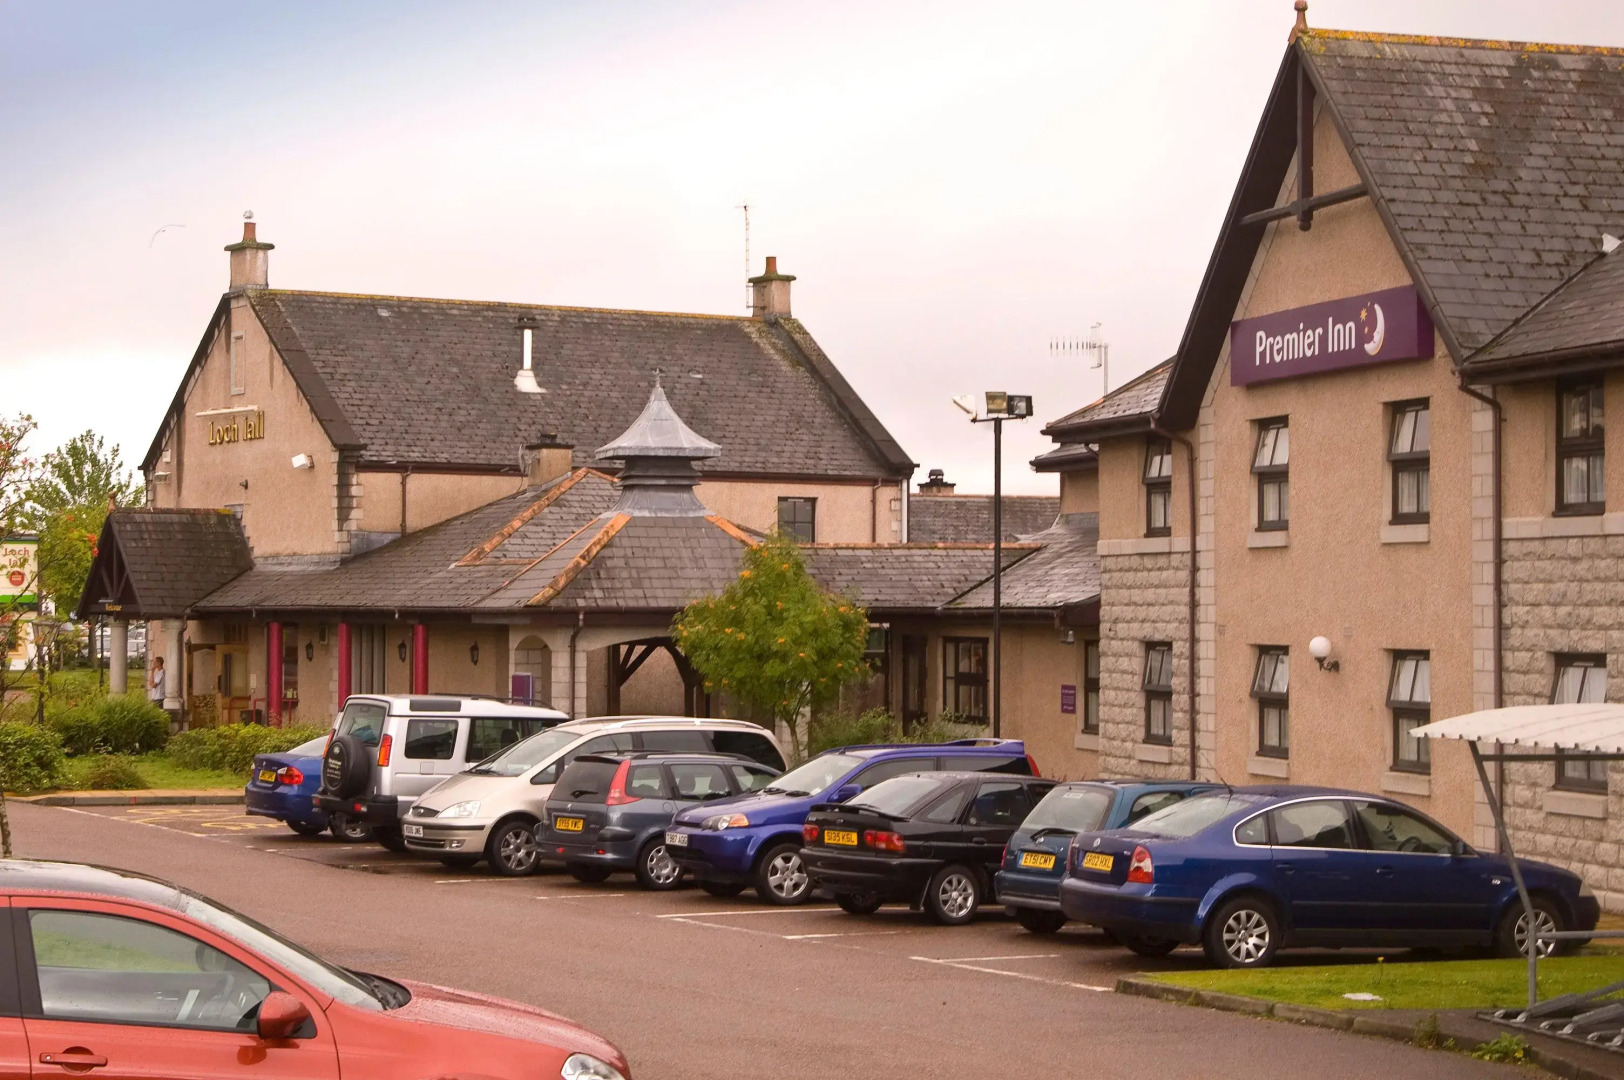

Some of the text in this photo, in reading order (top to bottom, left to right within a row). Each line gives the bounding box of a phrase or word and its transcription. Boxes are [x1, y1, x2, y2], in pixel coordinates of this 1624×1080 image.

[1255, 316, 1356, 366] Premier Inn
[208, 415, 239, 445] Loch
[4, 546, 30, 557] Loch
[842, 832, 855, 843] KSL
